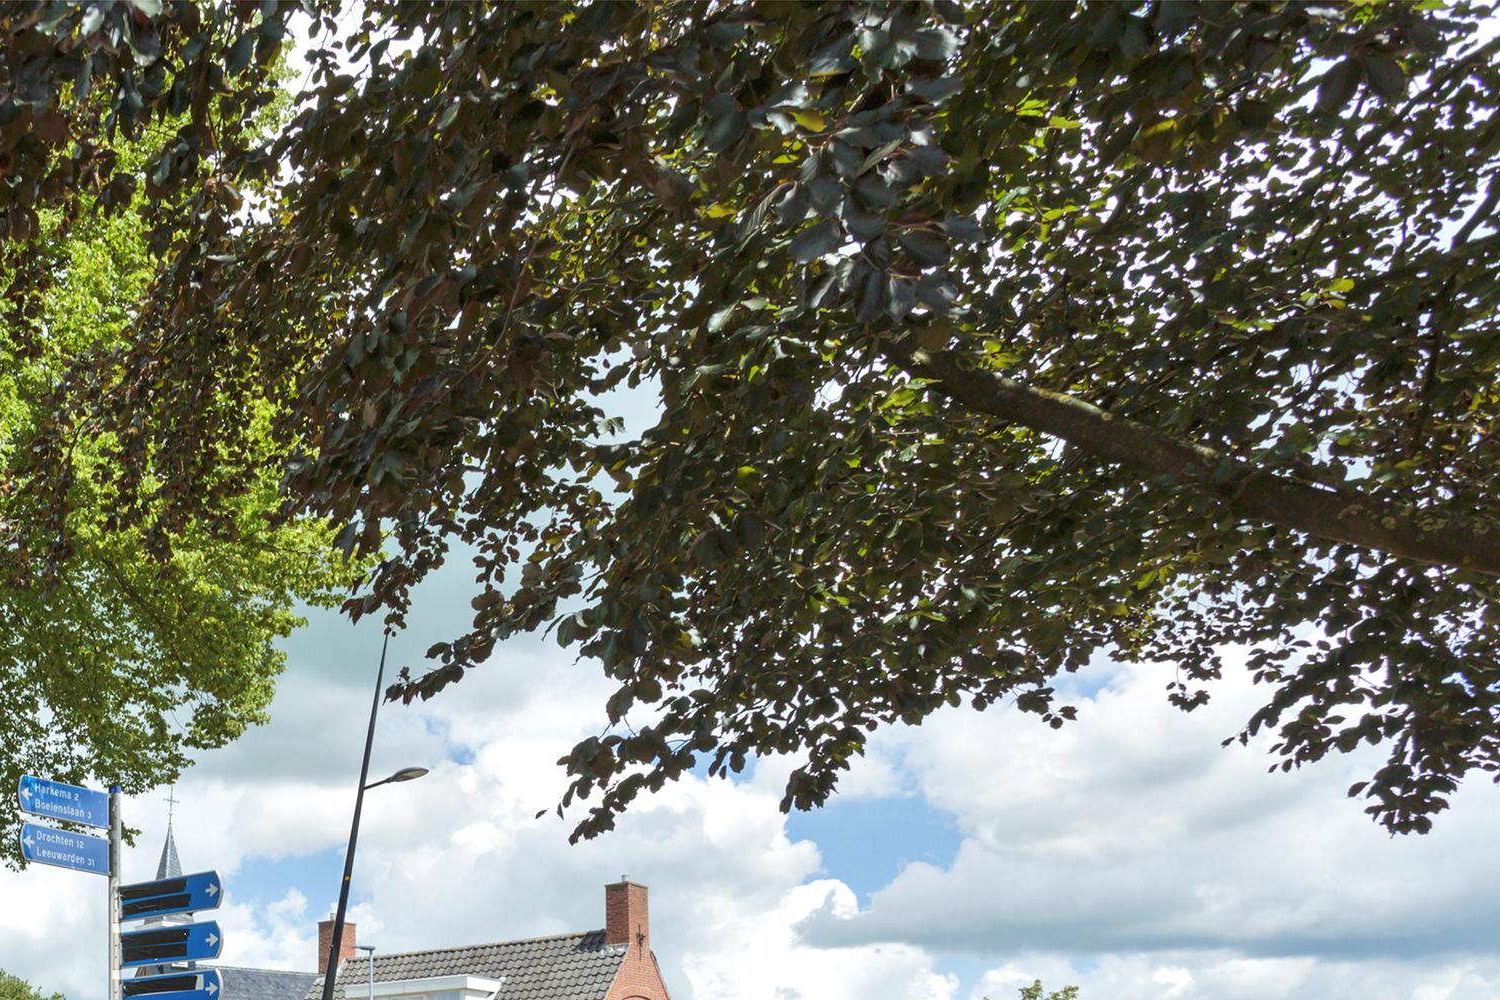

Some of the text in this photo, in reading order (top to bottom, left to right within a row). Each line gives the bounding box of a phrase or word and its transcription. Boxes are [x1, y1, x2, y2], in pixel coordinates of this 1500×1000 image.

[34, 783, 79, 801] Harkema 2
[34, 799, 84, 818] Boelenslaan
[36, 831, 74, 847] Drachten
[36, 847, 95, 866] Leeuwarden 31
